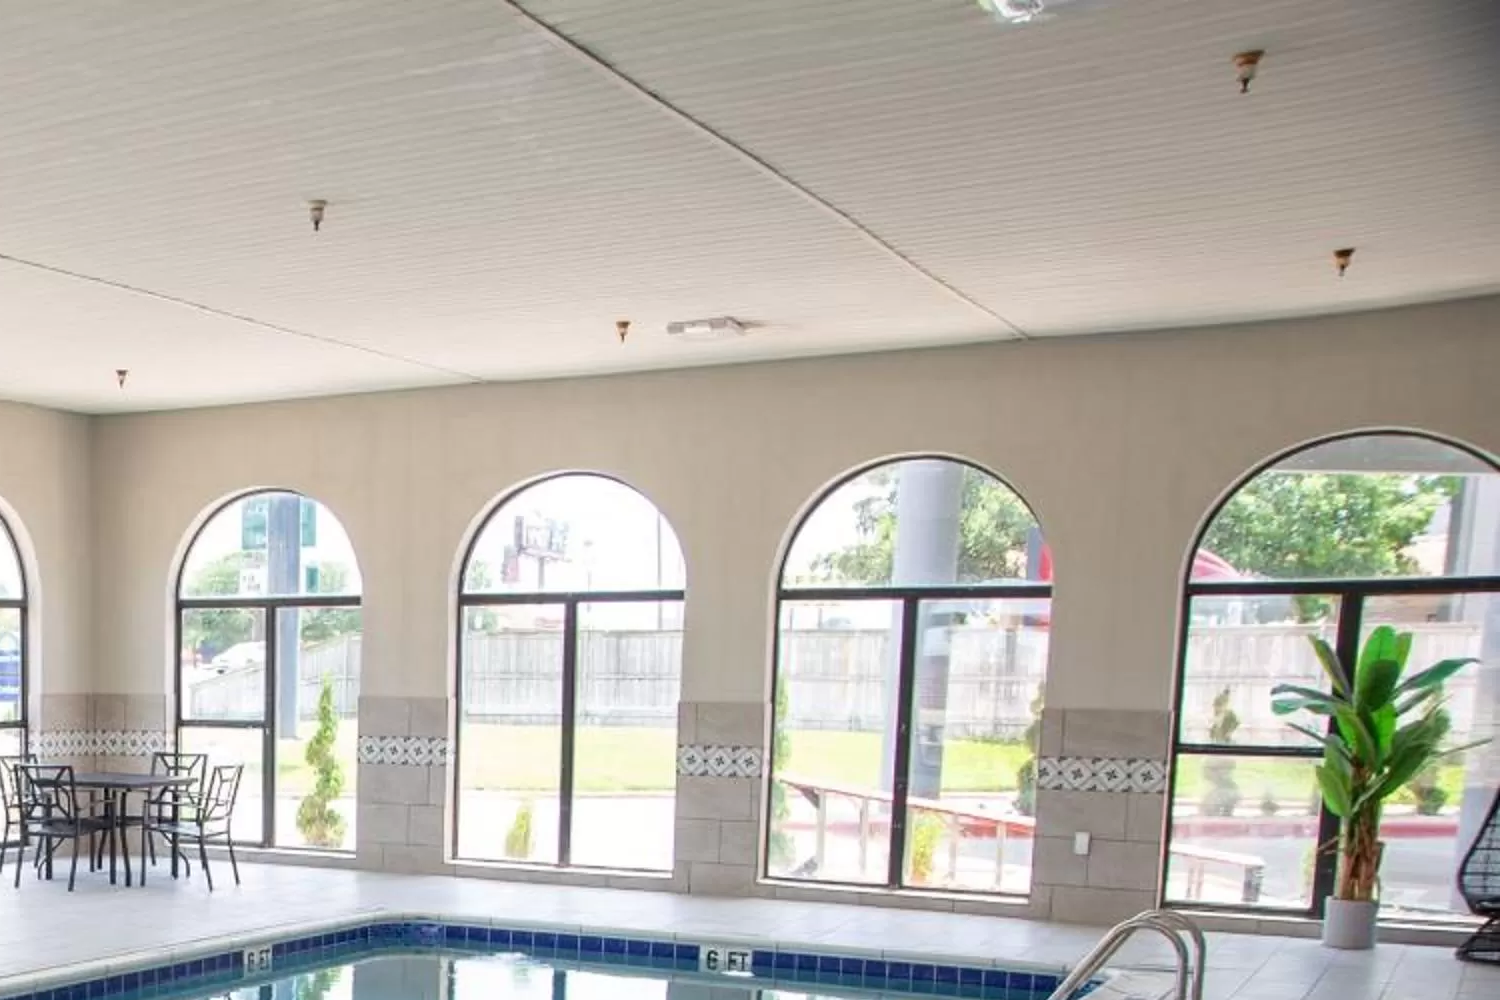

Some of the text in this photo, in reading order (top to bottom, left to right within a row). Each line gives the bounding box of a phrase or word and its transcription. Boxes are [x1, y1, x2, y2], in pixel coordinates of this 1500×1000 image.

[259, 948, 271, 970] FT
[707, 950, 749, 972] 6 FT
